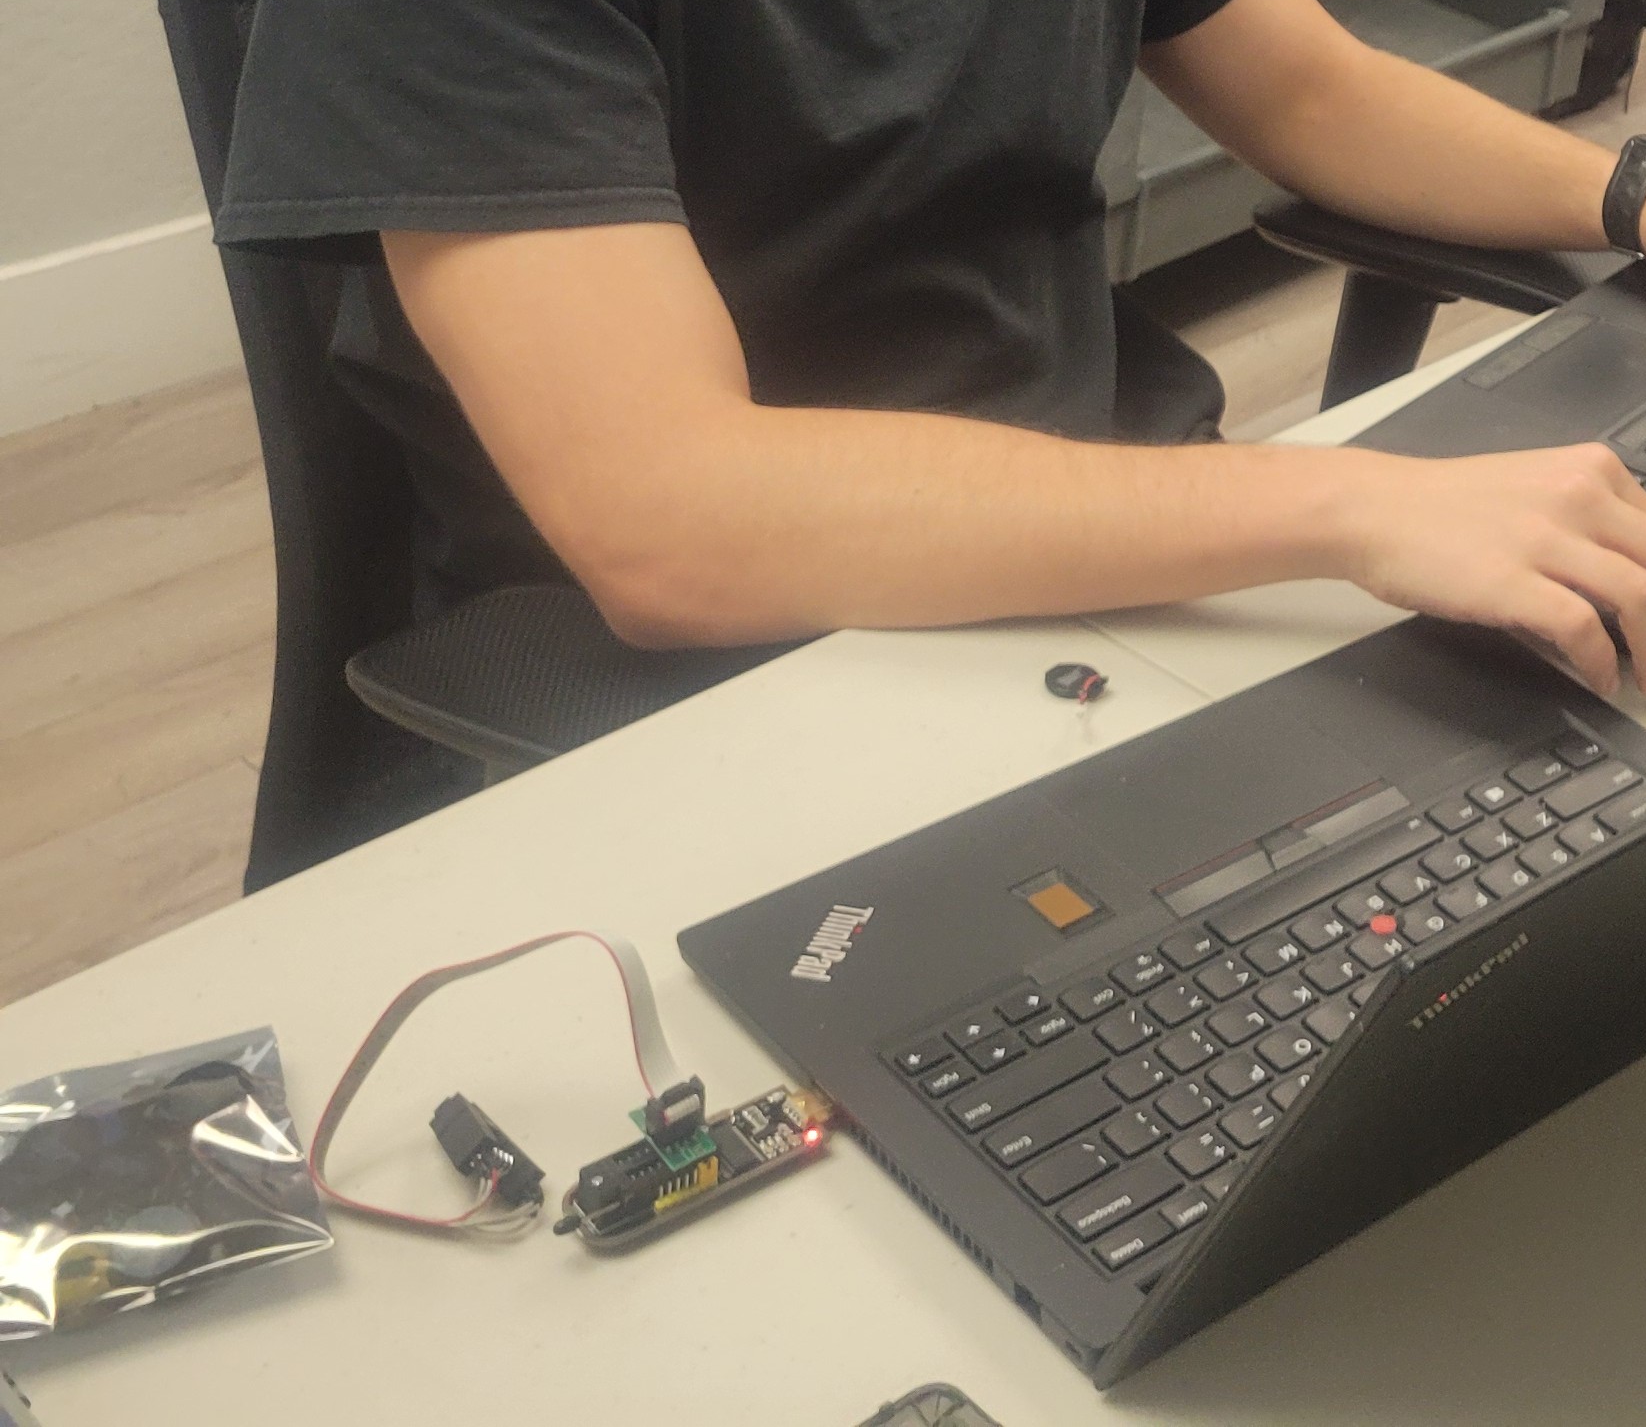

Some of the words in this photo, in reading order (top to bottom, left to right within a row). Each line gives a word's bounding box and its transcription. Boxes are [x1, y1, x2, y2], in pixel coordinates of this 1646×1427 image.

[791, 905, 874, 982] ThinkPad
[964, 1102, 992, 1121] Shift
[1002, 1135, 1033, 1155] Enter
[1078, 1194, 1132, 1229] Backspace
[1110, 1237, 1145, 1261] Delete
